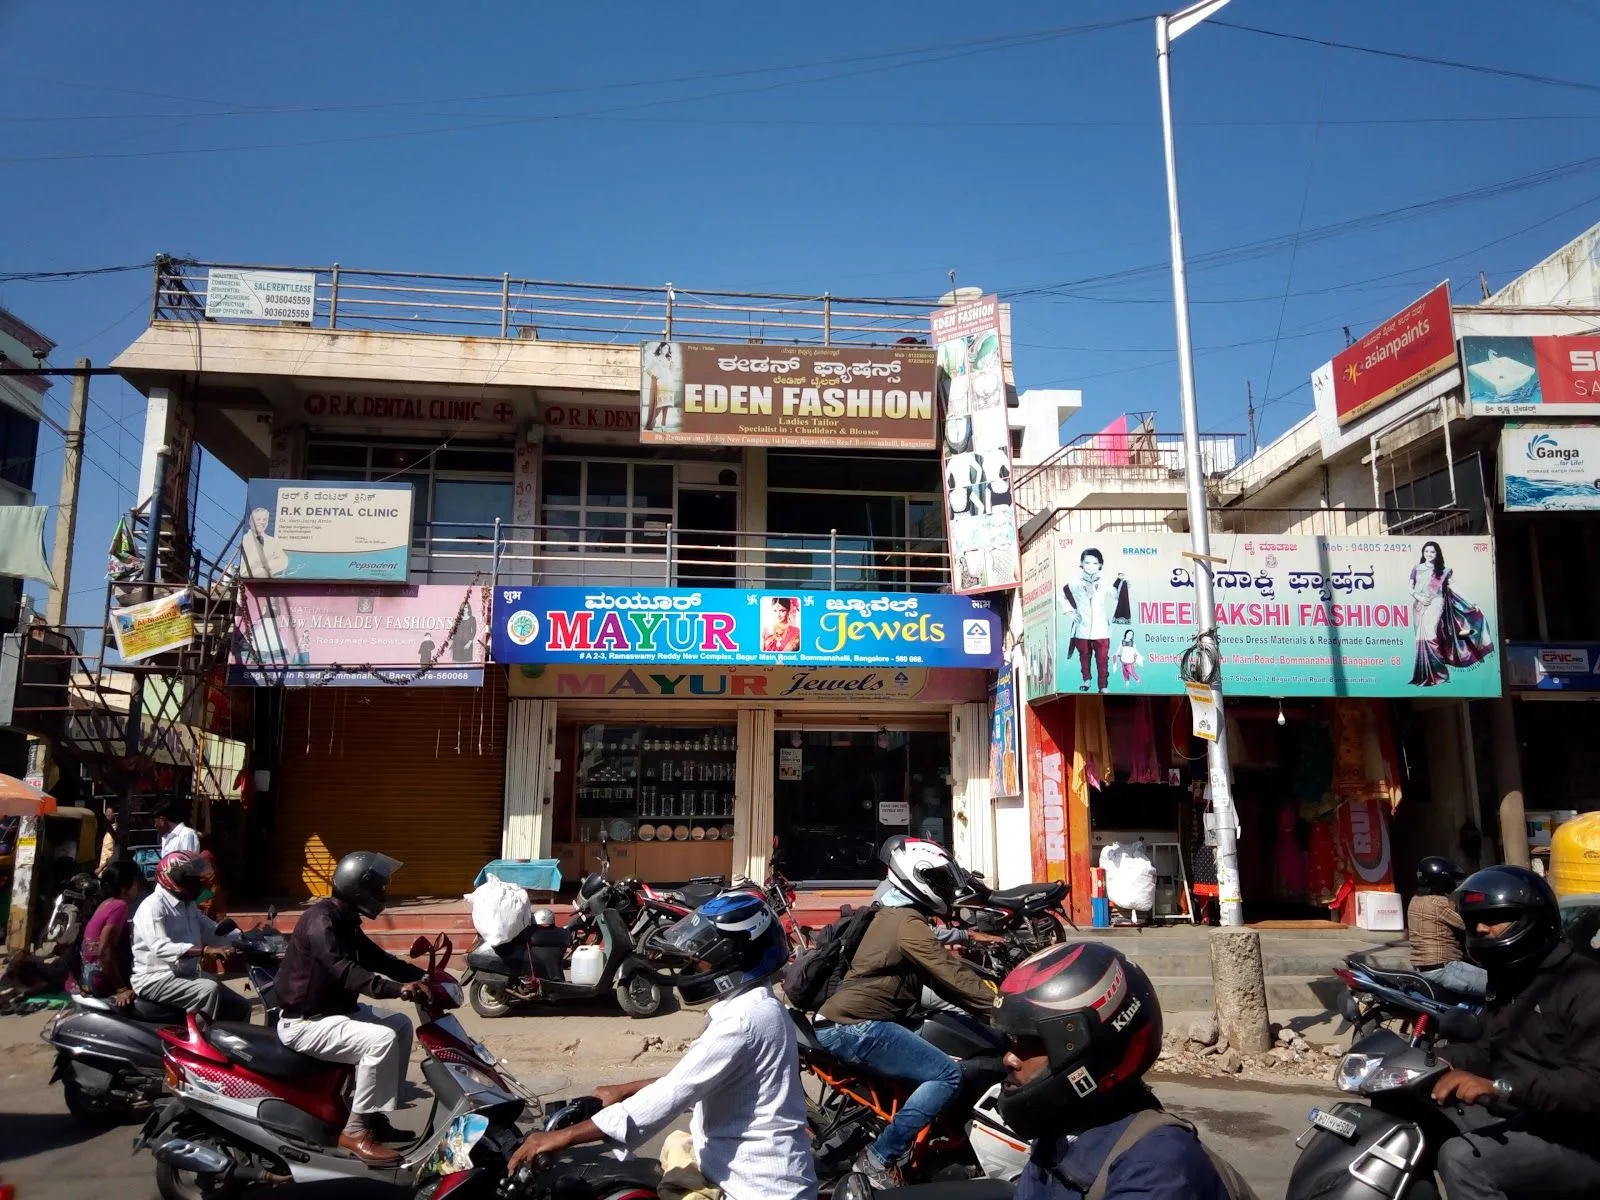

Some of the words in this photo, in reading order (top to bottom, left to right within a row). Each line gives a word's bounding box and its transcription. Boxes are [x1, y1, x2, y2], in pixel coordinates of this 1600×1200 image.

[265, 294, 311, 306] 9036045559
[264, 307, 310, 318] 9036025559
[933, 312, 957, 331] EDEN
[958, 302, 994, 324] FASHION
[1364, 318, 1430, 370] asianpaints
[1569, 350, 1600, 372] S
[684, 383, 773, 414] EDEN
[782, 387, 932, 420] FASHION
[363, 396, 424, 420] DENTAL
[430, 400, 480, 421] CLINIC
[778, 417, 807, 426] Ladies
[811, 418, 839, 426] Tailor
[738, 424, 776, 434] Specialist
[795, 426, 837, 435] Chudidars
[849, 427, 880, 436] Blouses
[1536, 446, 1580, 460] Ganga
[280, 506, 302, 516] R.K
[306, 507, 354, 517] DENTAL
[358, 508, 399, 518] CLINIC
[1122, 547, 1158, 555] BRANCH
[1322, 542, 1342, 552] Mob
[1351, 543, 1381, 552] 94805
[1384, 544, 1412, 552] 24921
[348, 560, 398, 570] Pepsodent
[504, 590, 522, 604] शुभ
[1140, 602, 1290, 627] MEEAKSHI
[1300, 604, 1410, 628] FASHION
[280, 616, 306, 630] New
[310, 616, 381, 630] MAHADEV
[386, 616, 455, 630] FASHIONS
[547, 611, 738, 651] MAYUR
[815, 612, 946, 653] Jewels
[316, 636, 368, 648] Readymade
[1145, 634, 1176, 643] Dealers
[1216, 634, 1244, 644] Sarees
[1246, 635, 1268, 644] Dress
[1270, 636, 1307, 646] Materials
[1310, 637, 1316, 645] &
[1318, 636, 1364, 646] Readymade
[1366, 636, 1404, 646] Garments
[609, 652, 656, 662] Ramaswamy
[656, 652, 681, 662] Reddy
[682, 652, 698, 661] New
[736, 653, 758, 662] Begur
[759, 654, 778, 662] Main
[854, 654, 889, 664] Bangalore
[896, 655, 908, 663] 560
[1232, 654, 1254, 664] Main
[1342, 656, 1384, 666] Bangalore
[1391, 656, 1401, 666] 68
[558, 668, 769, 696] MAYUR
[780, 672, 885, 696] Jewels
